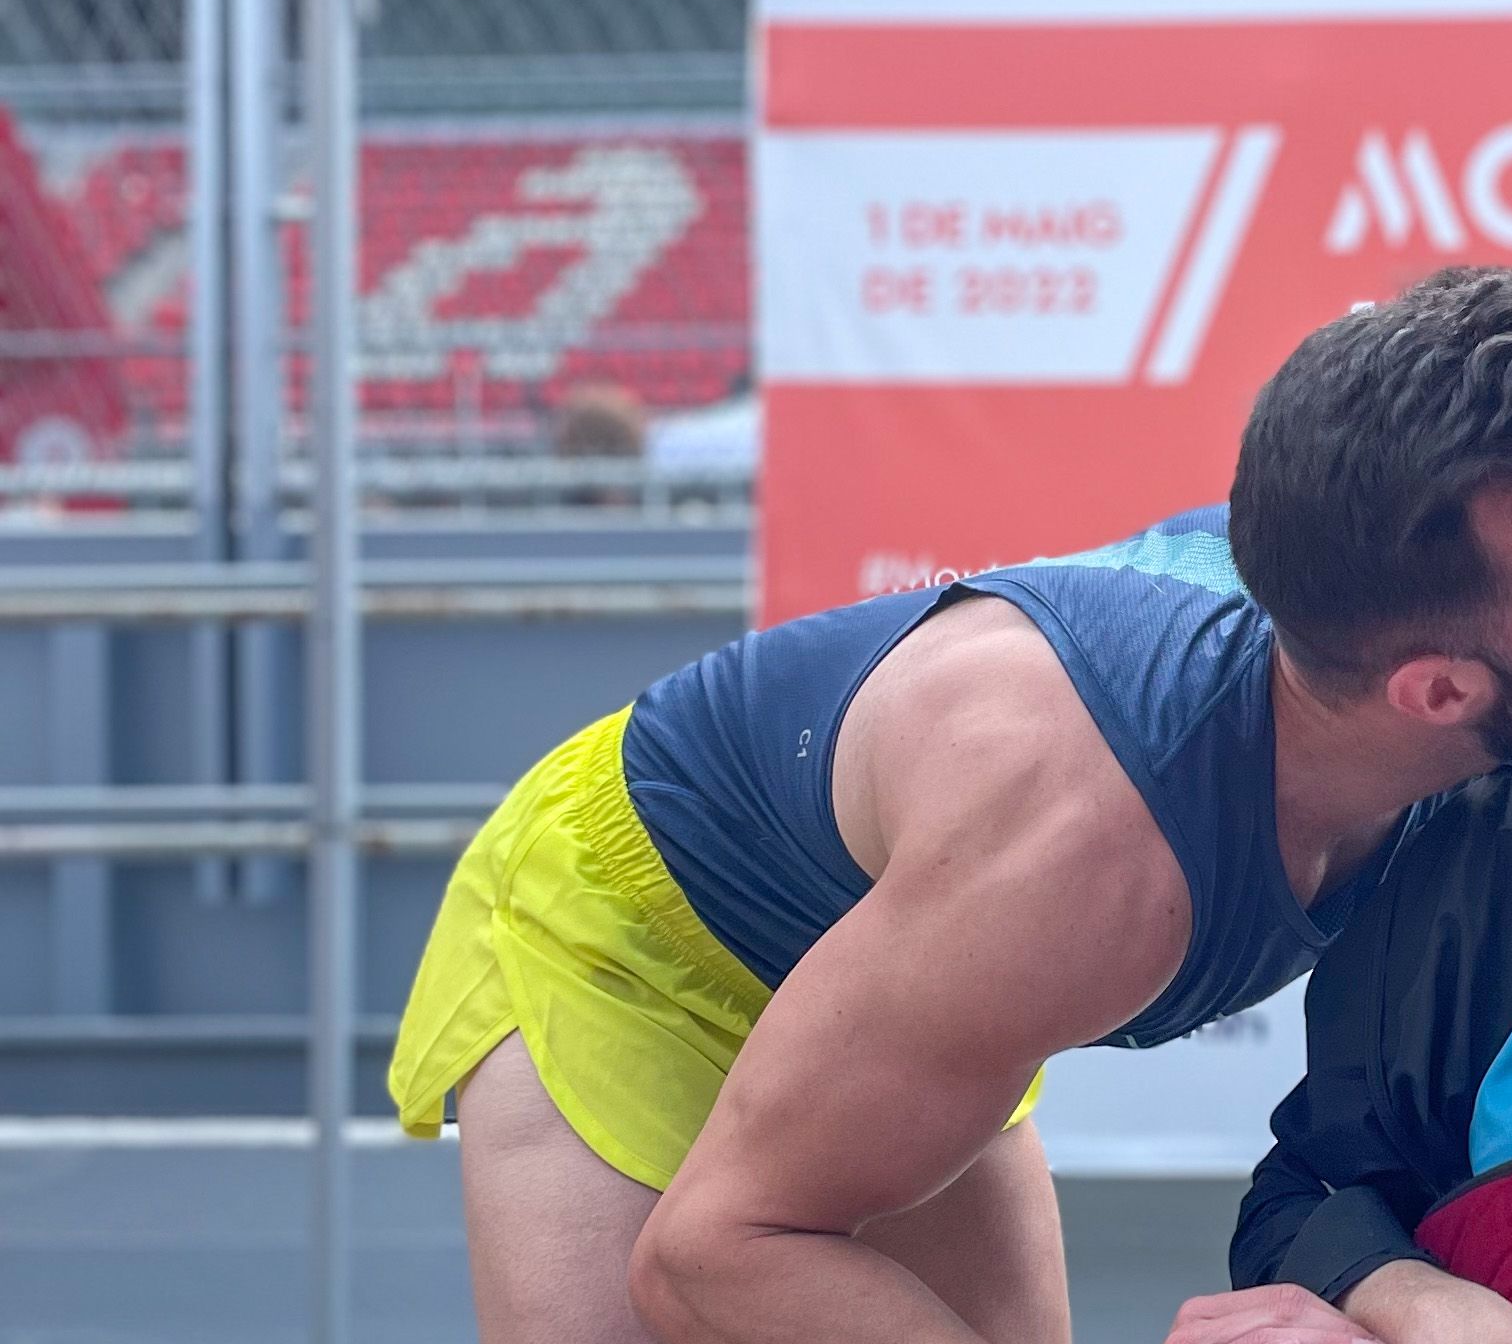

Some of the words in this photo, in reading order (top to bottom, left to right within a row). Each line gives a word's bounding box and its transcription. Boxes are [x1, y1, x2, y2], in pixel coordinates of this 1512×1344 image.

[866, 201, 890, 248] 1
[902, 202, 966, 248] DE
[982, 201, 1122, 249] MAIG
[862, 266, 934, 314] DE
[955, 266, 1096, 314] 2022
